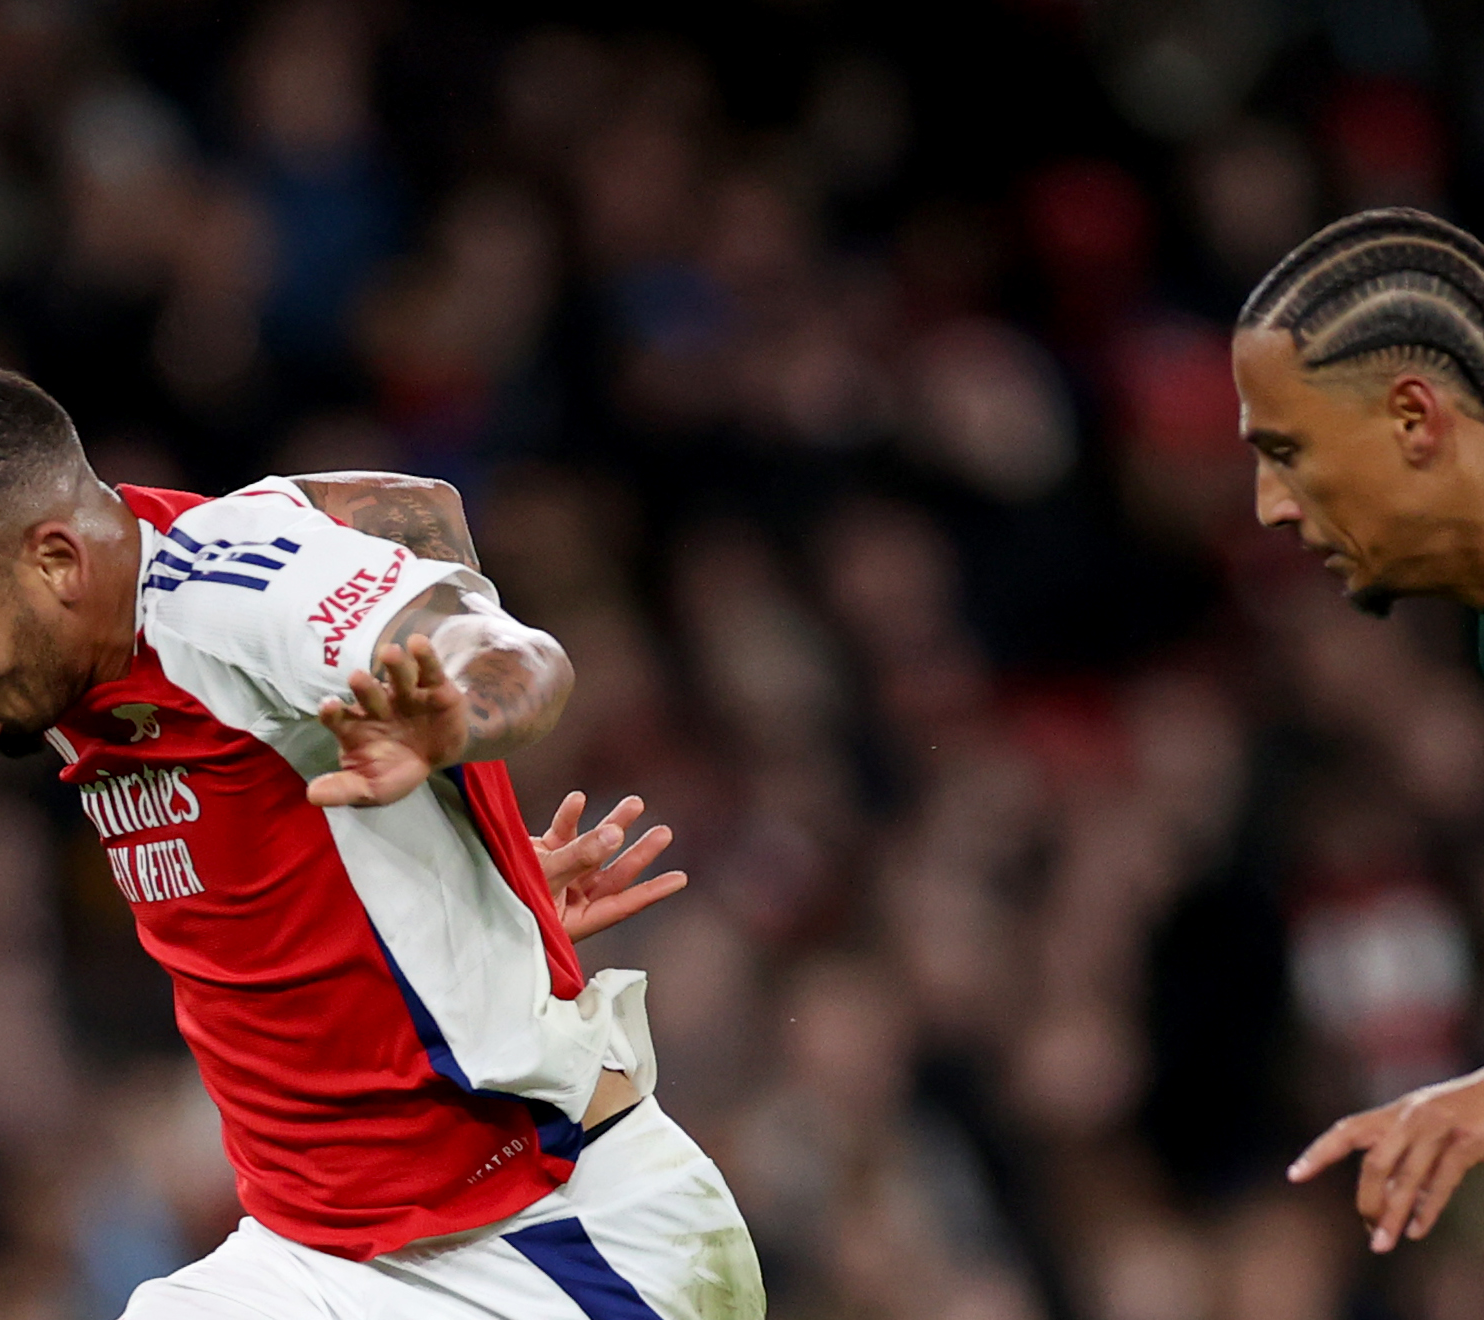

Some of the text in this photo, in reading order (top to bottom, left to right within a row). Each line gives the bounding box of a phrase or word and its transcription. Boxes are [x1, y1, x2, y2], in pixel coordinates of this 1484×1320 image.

[307, 567, 379, 624] VISIT
[79, 763, 200, 838] mirates
[135, 838, 205, 903] BETTER
